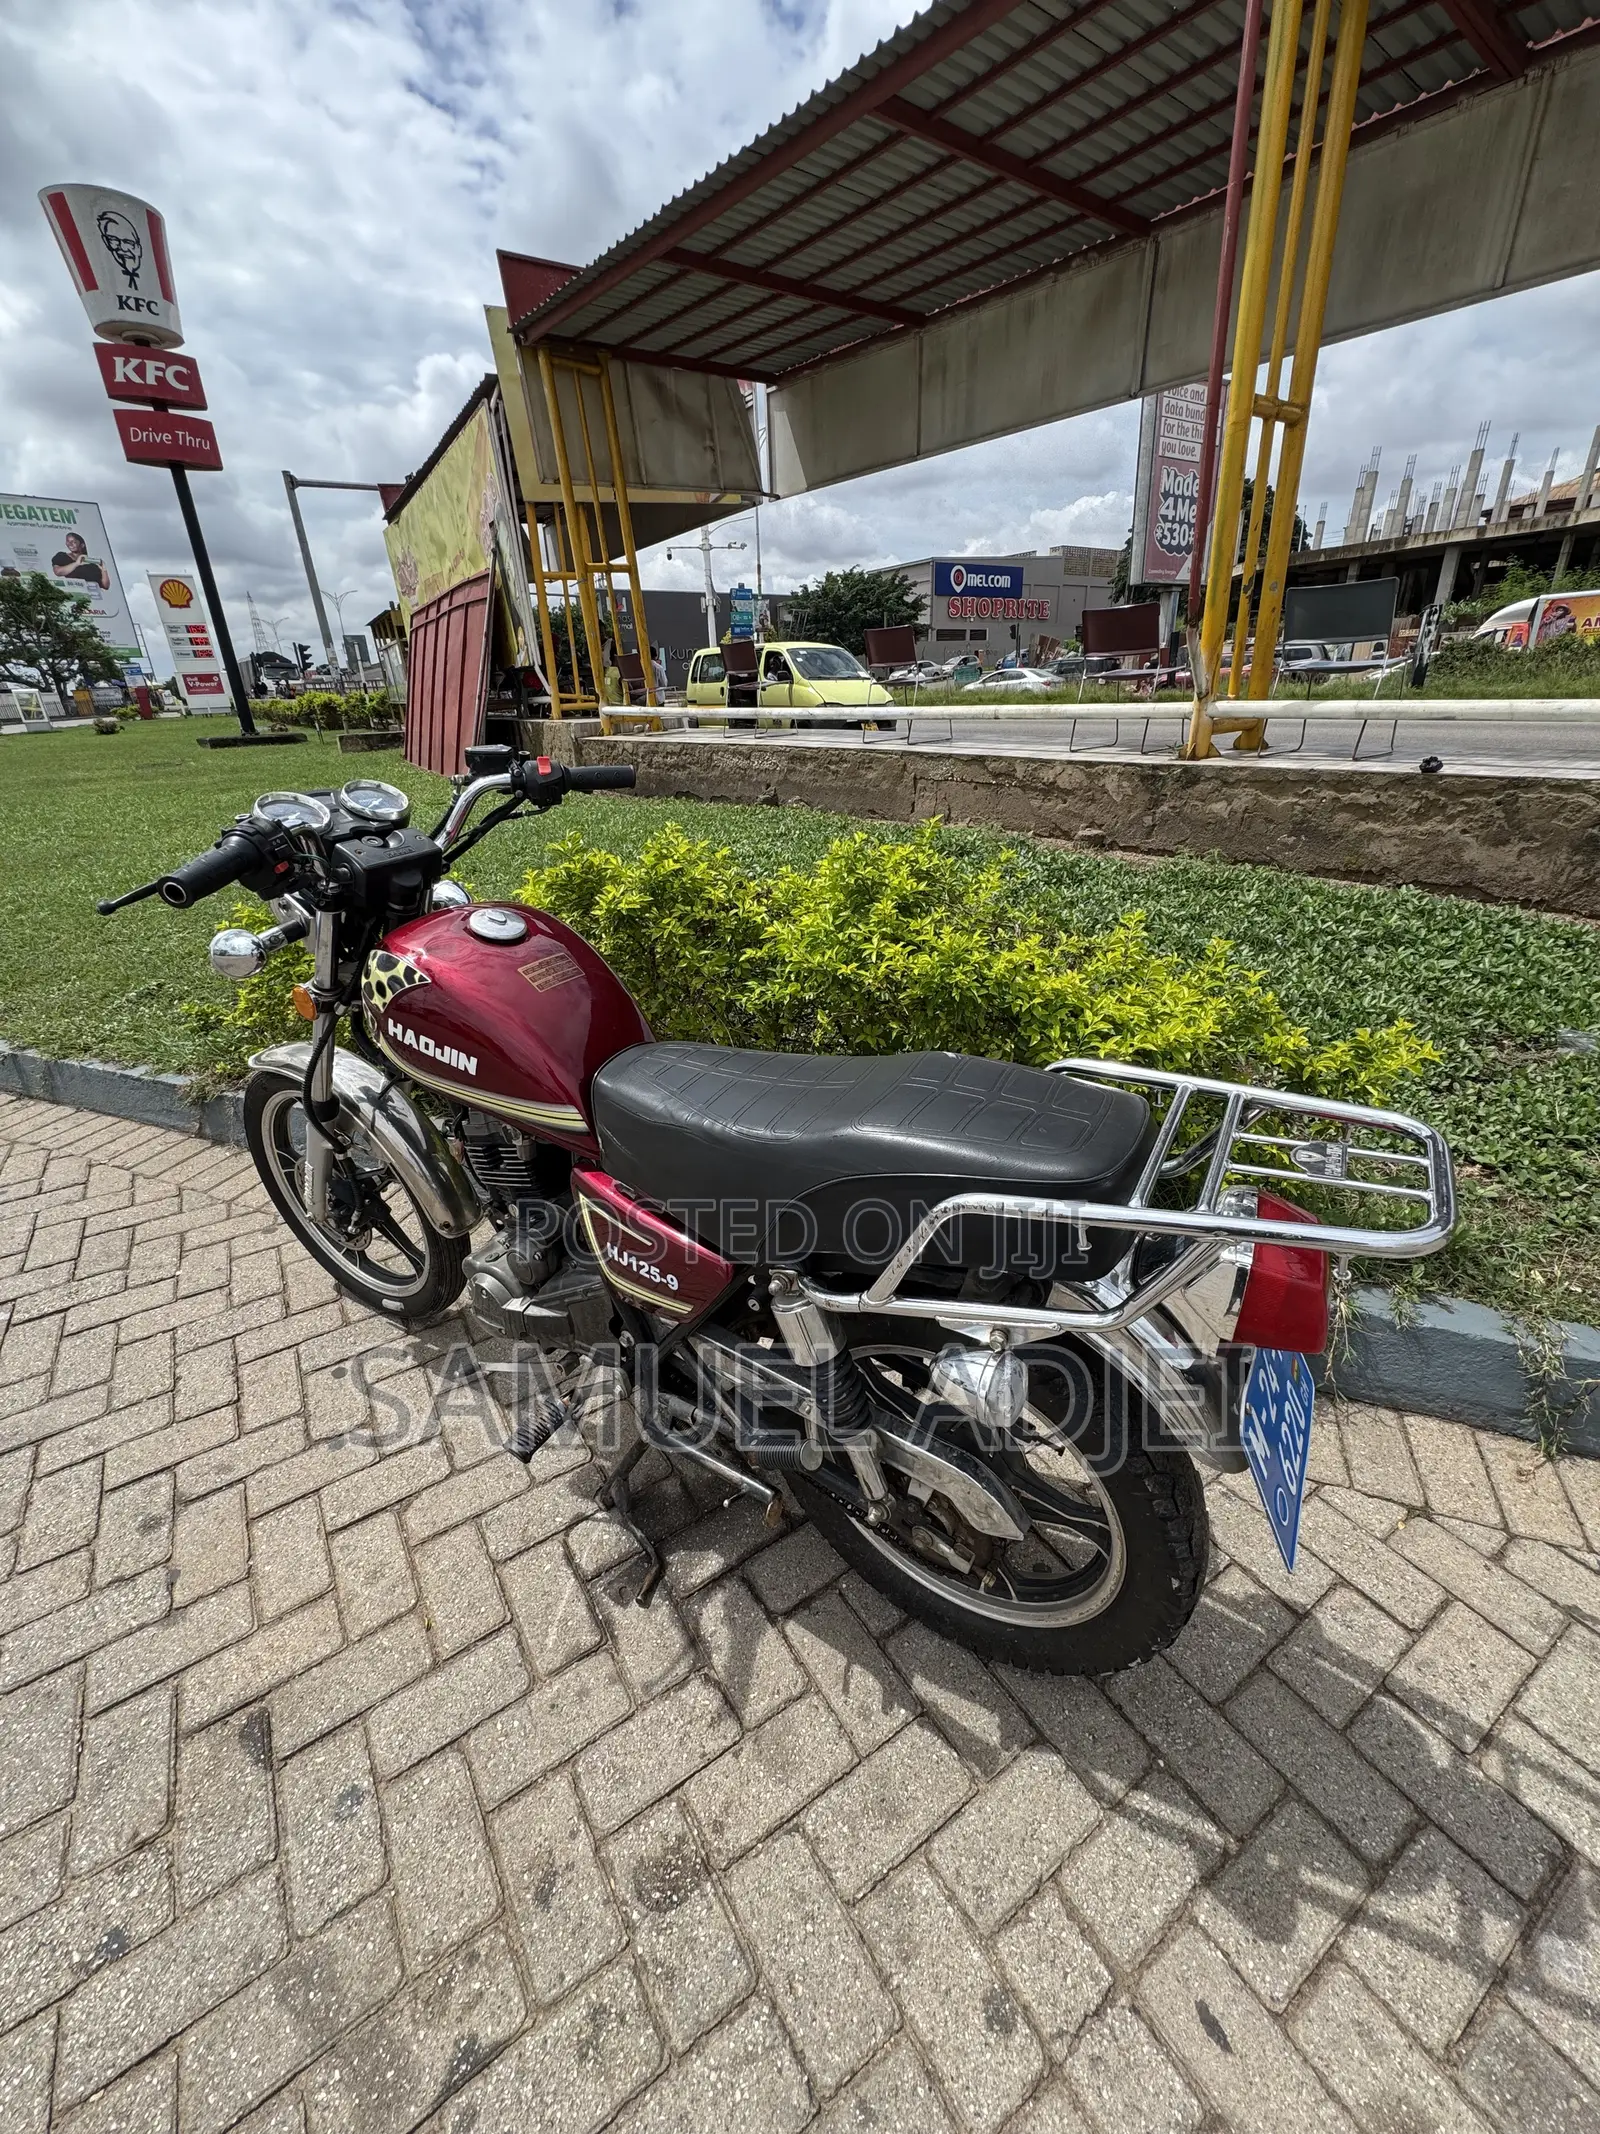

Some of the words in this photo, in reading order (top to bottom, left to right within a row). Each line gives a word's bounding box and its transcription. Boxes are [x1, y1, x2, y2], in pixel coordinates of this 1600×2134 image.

[116, 294, 160, 316] KFC
[112, 356, 190, 391] KFC
[1190, 388, 1206, 402] and
[1164, 400, 1184, 417] data
[1185, 404, 1206, 421] bund
[129, 426, 172, 445] Drive
[174, 429, 210, 451] Thru
[1163, 419, 1176, 436] for
[1177, 422, 1190, 437] the
[1191, 424, 1204, 440] thi
[1161, 441, 1177, 456] you
[1178, 442, 1197, 457] love.
[1161, 468, 1199, 497] Made
[0, 503, 77, 525] EGATEM
[967, 573, 1011, 588] MELCOM
[948, 596, 1050, 619] SHOPRITE
[668, 645, 697, 660] kum
[387, 1017, 478, 1077] HAOJIN
[606, 1241, 680, 1292] HJ125-9
[1279, 1379, 1307, 1496] 6220
